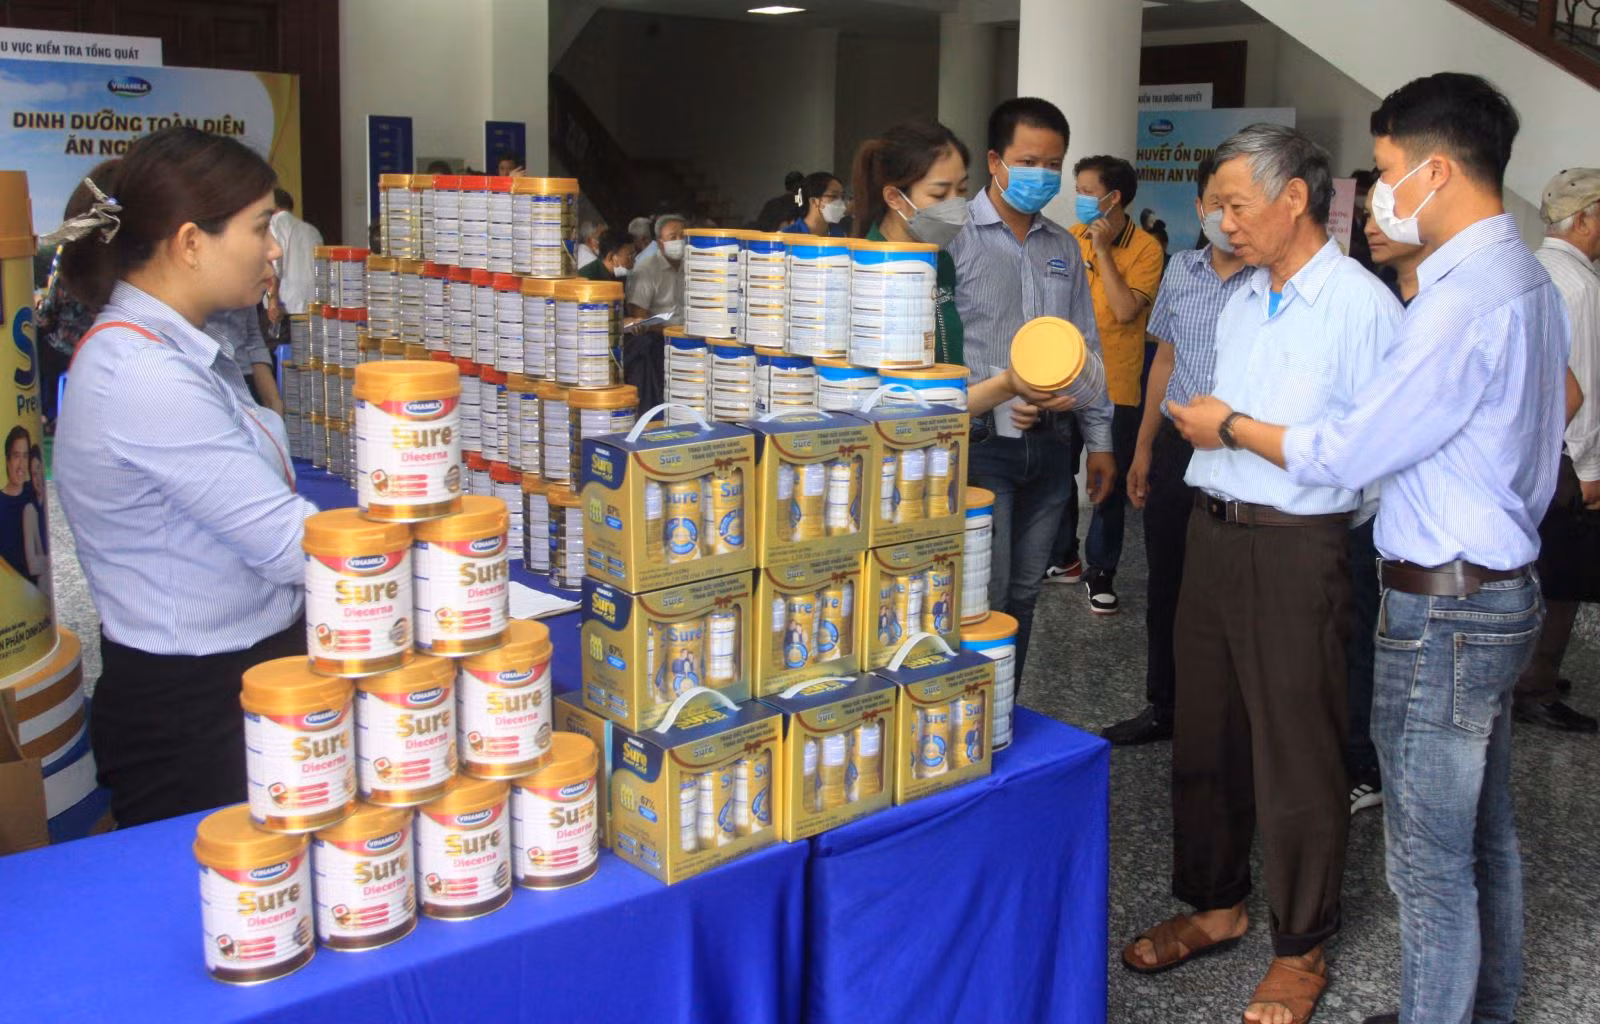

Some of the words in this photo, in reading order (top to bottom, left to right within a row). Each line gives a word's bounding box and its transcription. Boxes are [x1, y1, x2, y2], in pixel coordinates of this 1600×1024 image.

[11, 41, 33, 56] VỰC
[36, 40, 60, 55] KIỂM
[63, 45, 83, 57] TRA
[85, 43, 112, 59] TỔNG
[114, 46, 140, 60] QUÁT
[13, 111, 65, 129] DINH
[70, 108, 143, 132] DƯỠNG
[65, 134, 93, 155] ĂN
[1167, 168, 1184, 183] AN
[391, 425, 453, 449] Sure
[401, 450, 449, 463] Diecerna
[659, 453, 682, 466] Sure
[349, 556, 386, 566] VINAMILK
[335, 578, 399, 606] Sure
[343, 604, 394, 617] Diecerna
[486, 689, 543, 716] Sure
[395, 710, 451, 738] Sure
[494, 712, 539, 727] Diecerna
[622, 742, 648, 764] Sure
[444, 829, 501, 857] Sure
[237, 882, 301, 916] Sure
[246, 907, 297, 928] Diecerna
